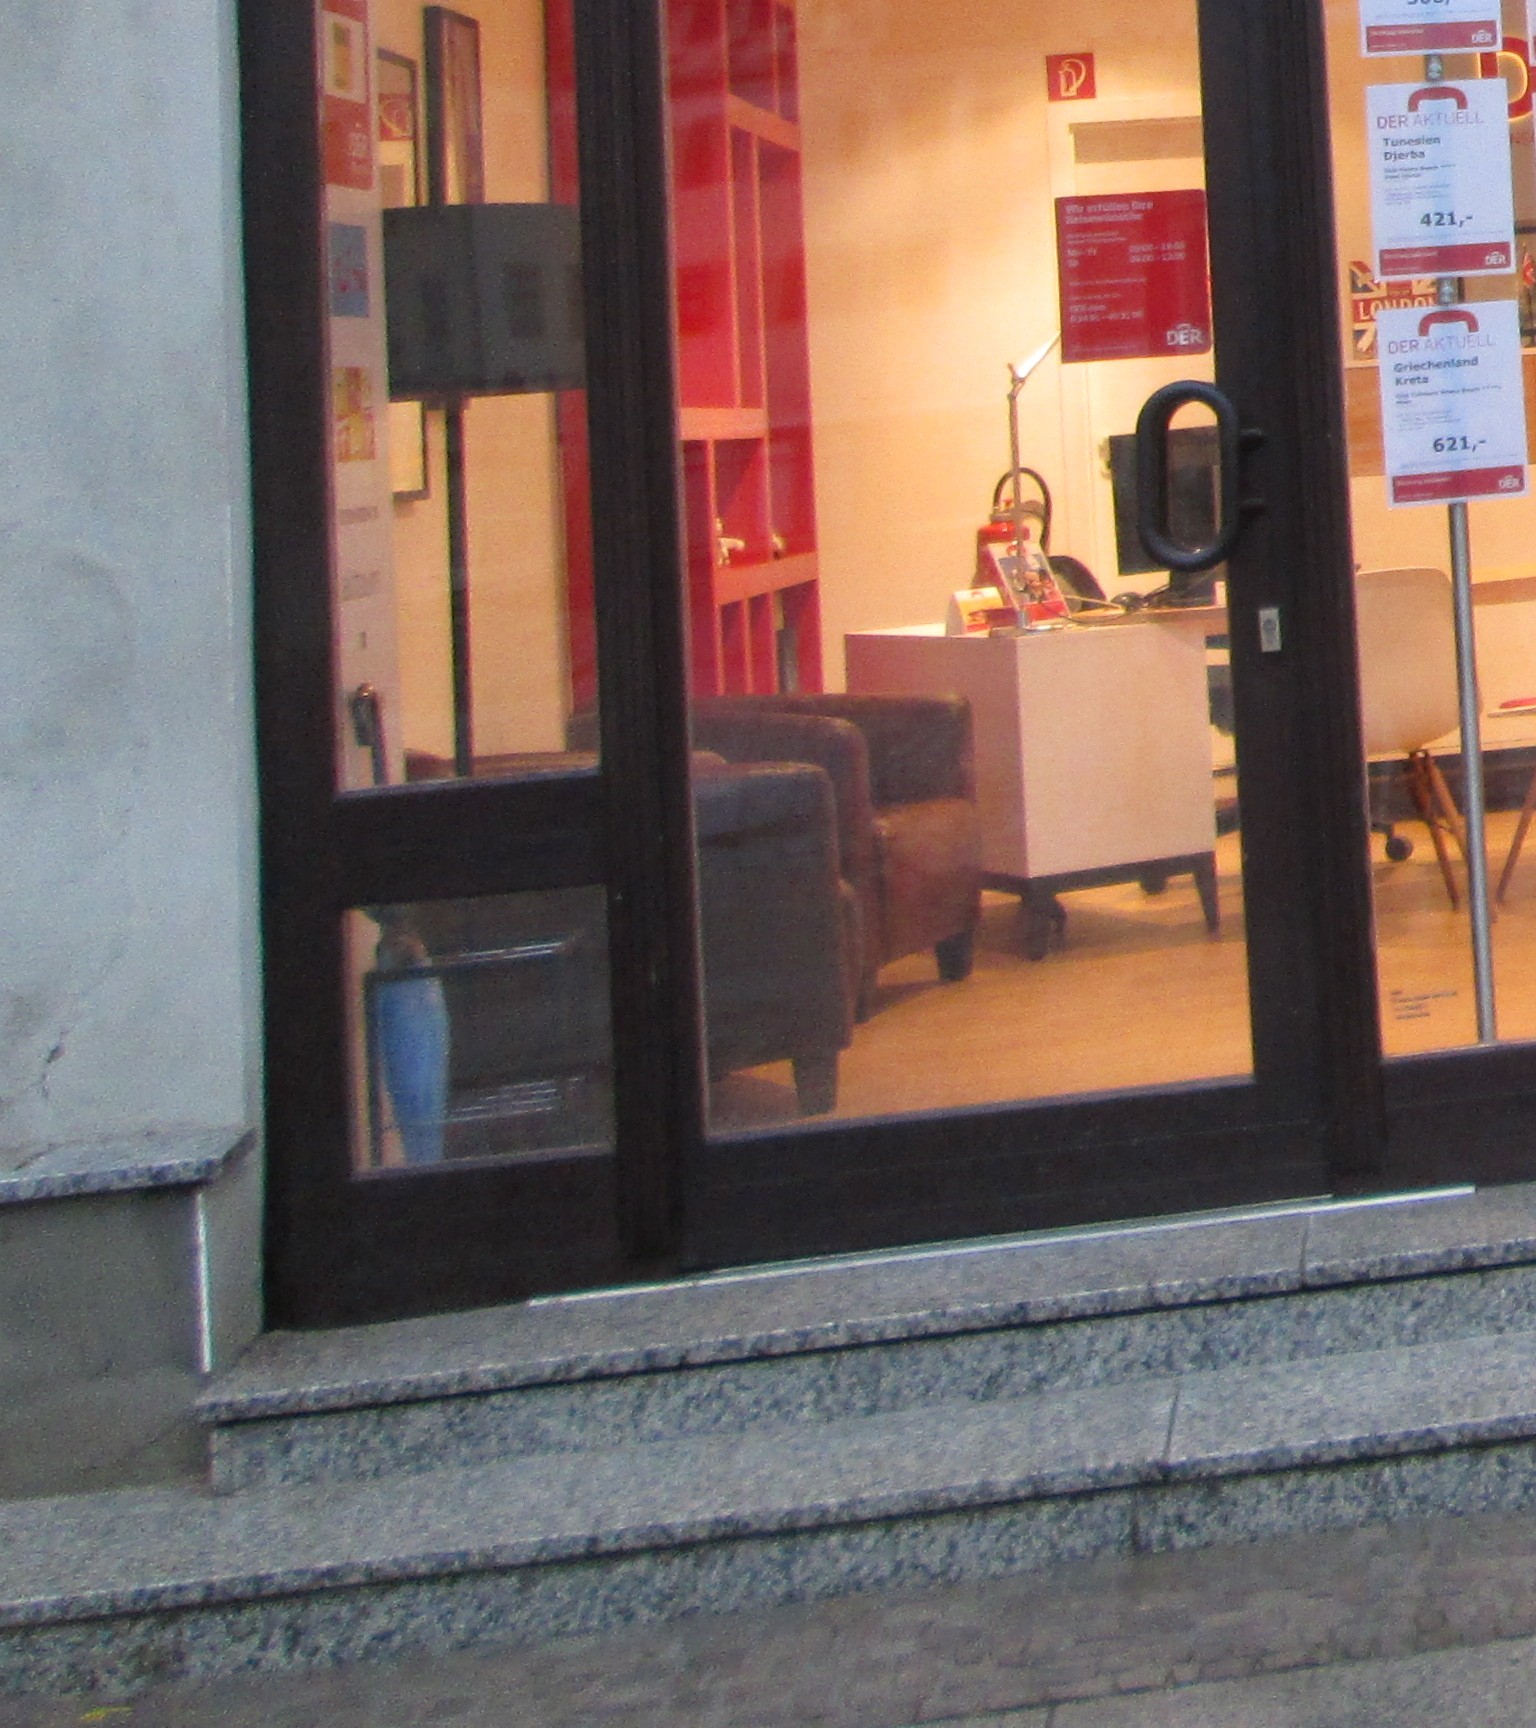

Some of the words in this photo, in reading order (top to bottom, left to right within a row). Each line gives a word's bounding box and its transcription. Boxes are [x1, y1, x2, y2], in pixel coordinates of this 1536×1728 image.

[1376, 113, 1409, 130] DER
[1413, 110, 1485, 127] AKTUELL
[1382, 135, 1441, 147] Tunesien
[1383, 149, 1426, 162] Djerba
[1419, 211, 1474, 228] 421,-
[1387, 338, 1420, 355] DER
[1423, 333, 1497, 353] AKTUELL
[1393, 356, 1479, 373] Griechenland
[1394, 374, 1430, 387] Kreta
[1432, 435, 1487, 453] 621,-
